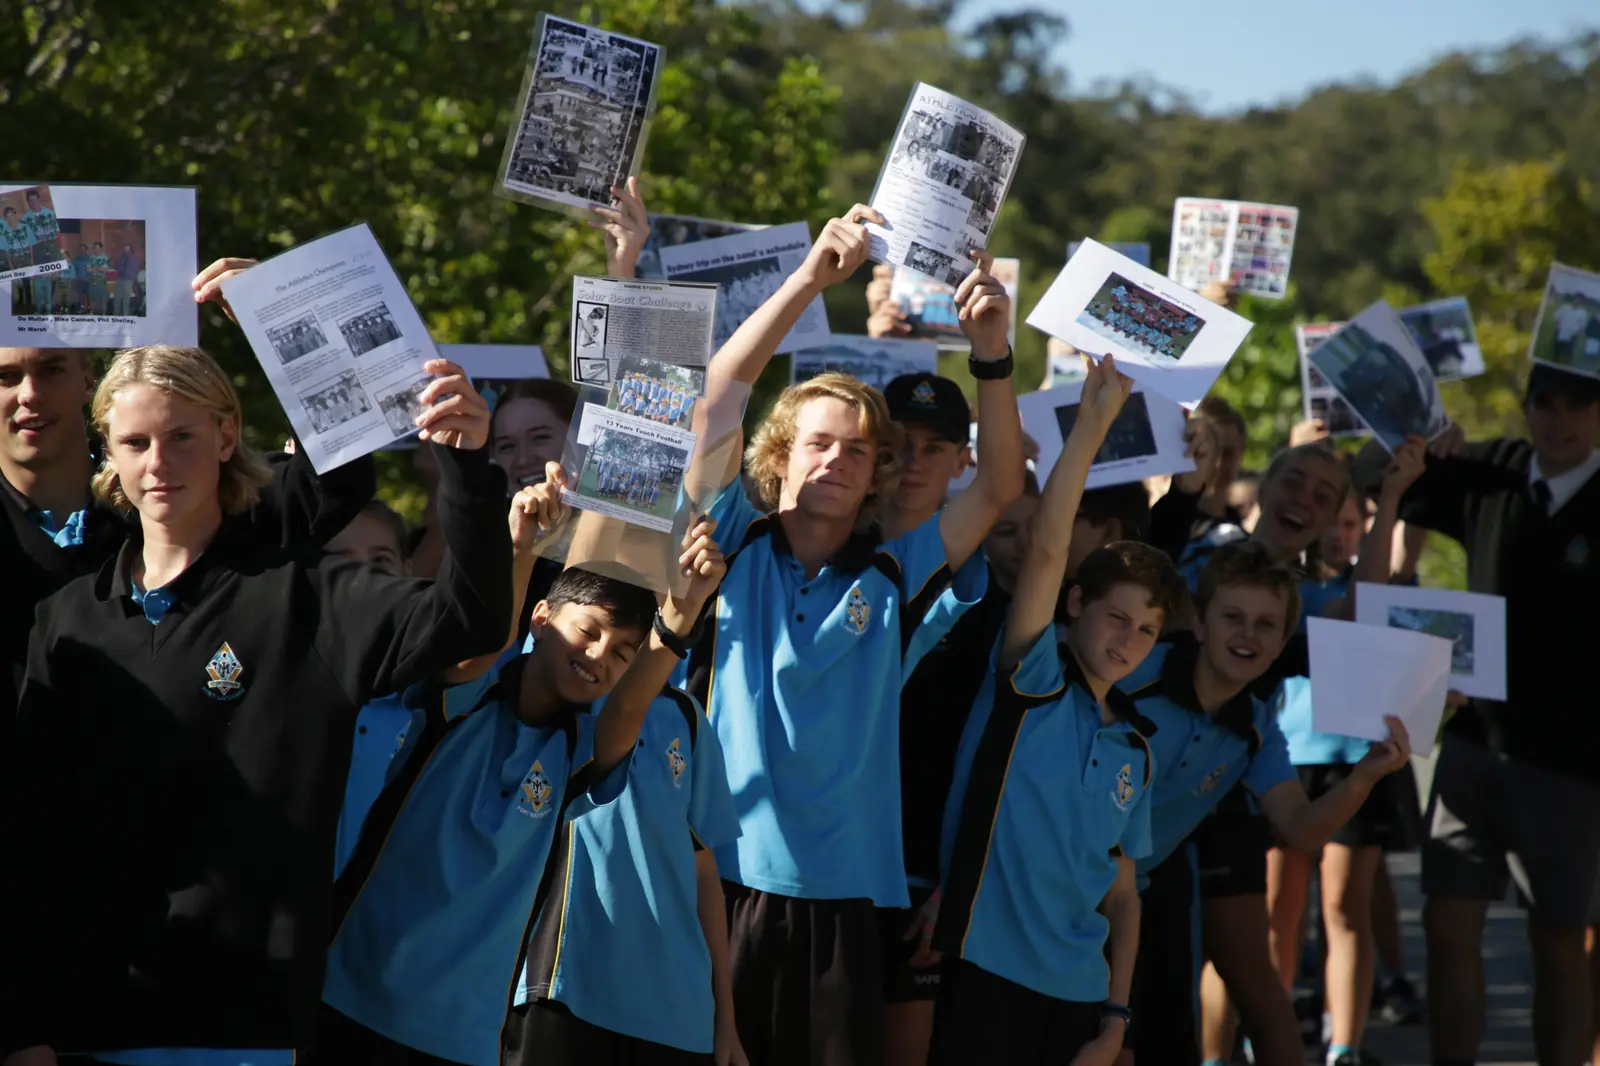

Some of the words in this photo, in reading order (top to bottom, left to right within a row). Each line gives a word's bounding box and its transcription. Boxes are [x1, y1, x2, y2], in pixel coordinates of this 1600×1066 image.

[39, 262, 62, 272] 2000
[667, 262, 695, 274] Sydney
[696, 257, 710, 269] trip
[722, 253, 735, 263] the
[766, 241, 806, 255] schedule
[274, 284, 288, 292] The
[577, 289, 606, 302] Solar
[608, 292, 635, 305] Boat
[638, 296, 693, 311] Challenge
[615, 422, 635, 433] Years
[635, 427, 656, 438] Touch
[656, 432, 683, 446] Football
